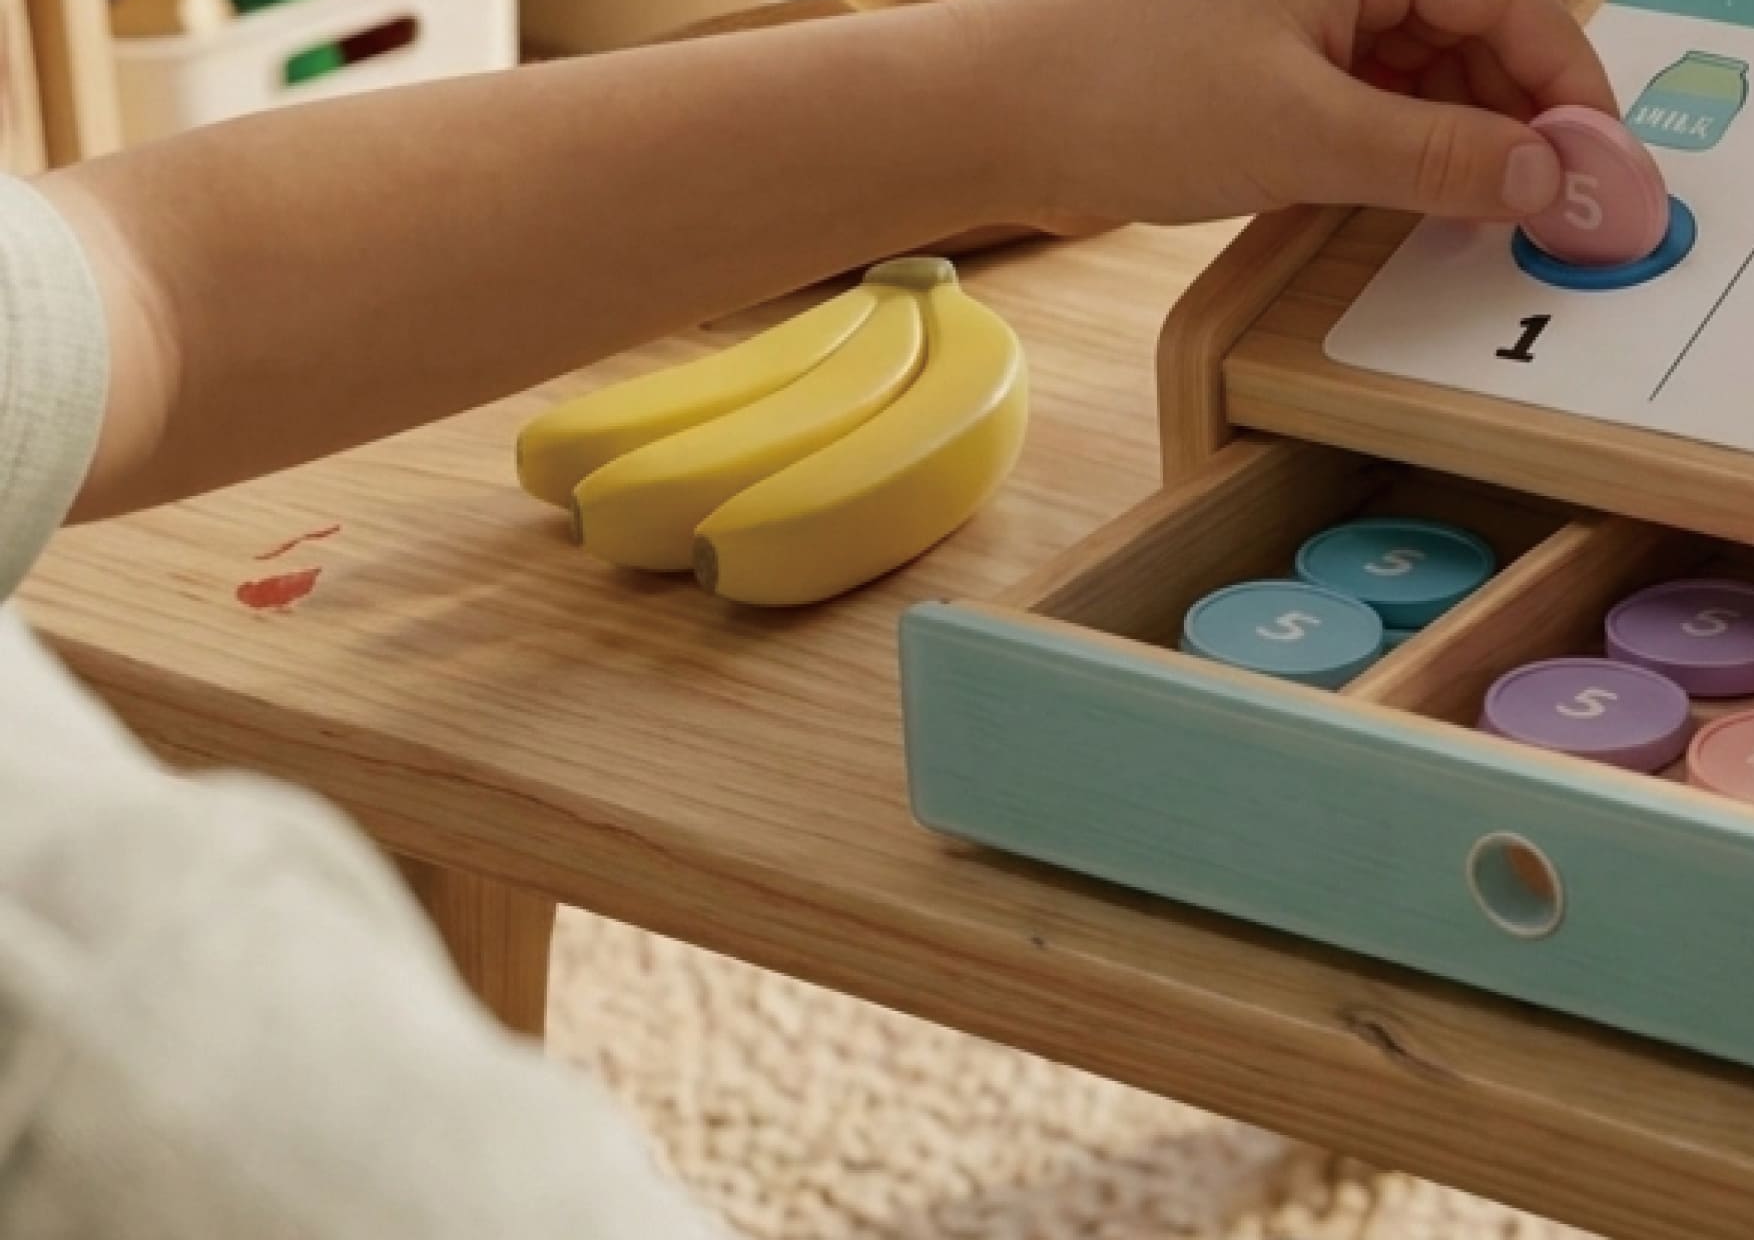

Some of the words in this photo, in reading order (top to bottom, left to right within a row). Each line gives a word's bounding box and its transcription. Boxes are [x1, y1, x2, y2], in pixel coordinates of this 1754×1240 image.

[1563, 173, 1603, 230] 5
[1495, 313, 1552, 363] 1
[1363, 547, 1425, 577] 5
[1255, 609, 1322, 643] 5
[1680, 607, 1735, 639] 5
[1555, 685, 1618, 720] 5
